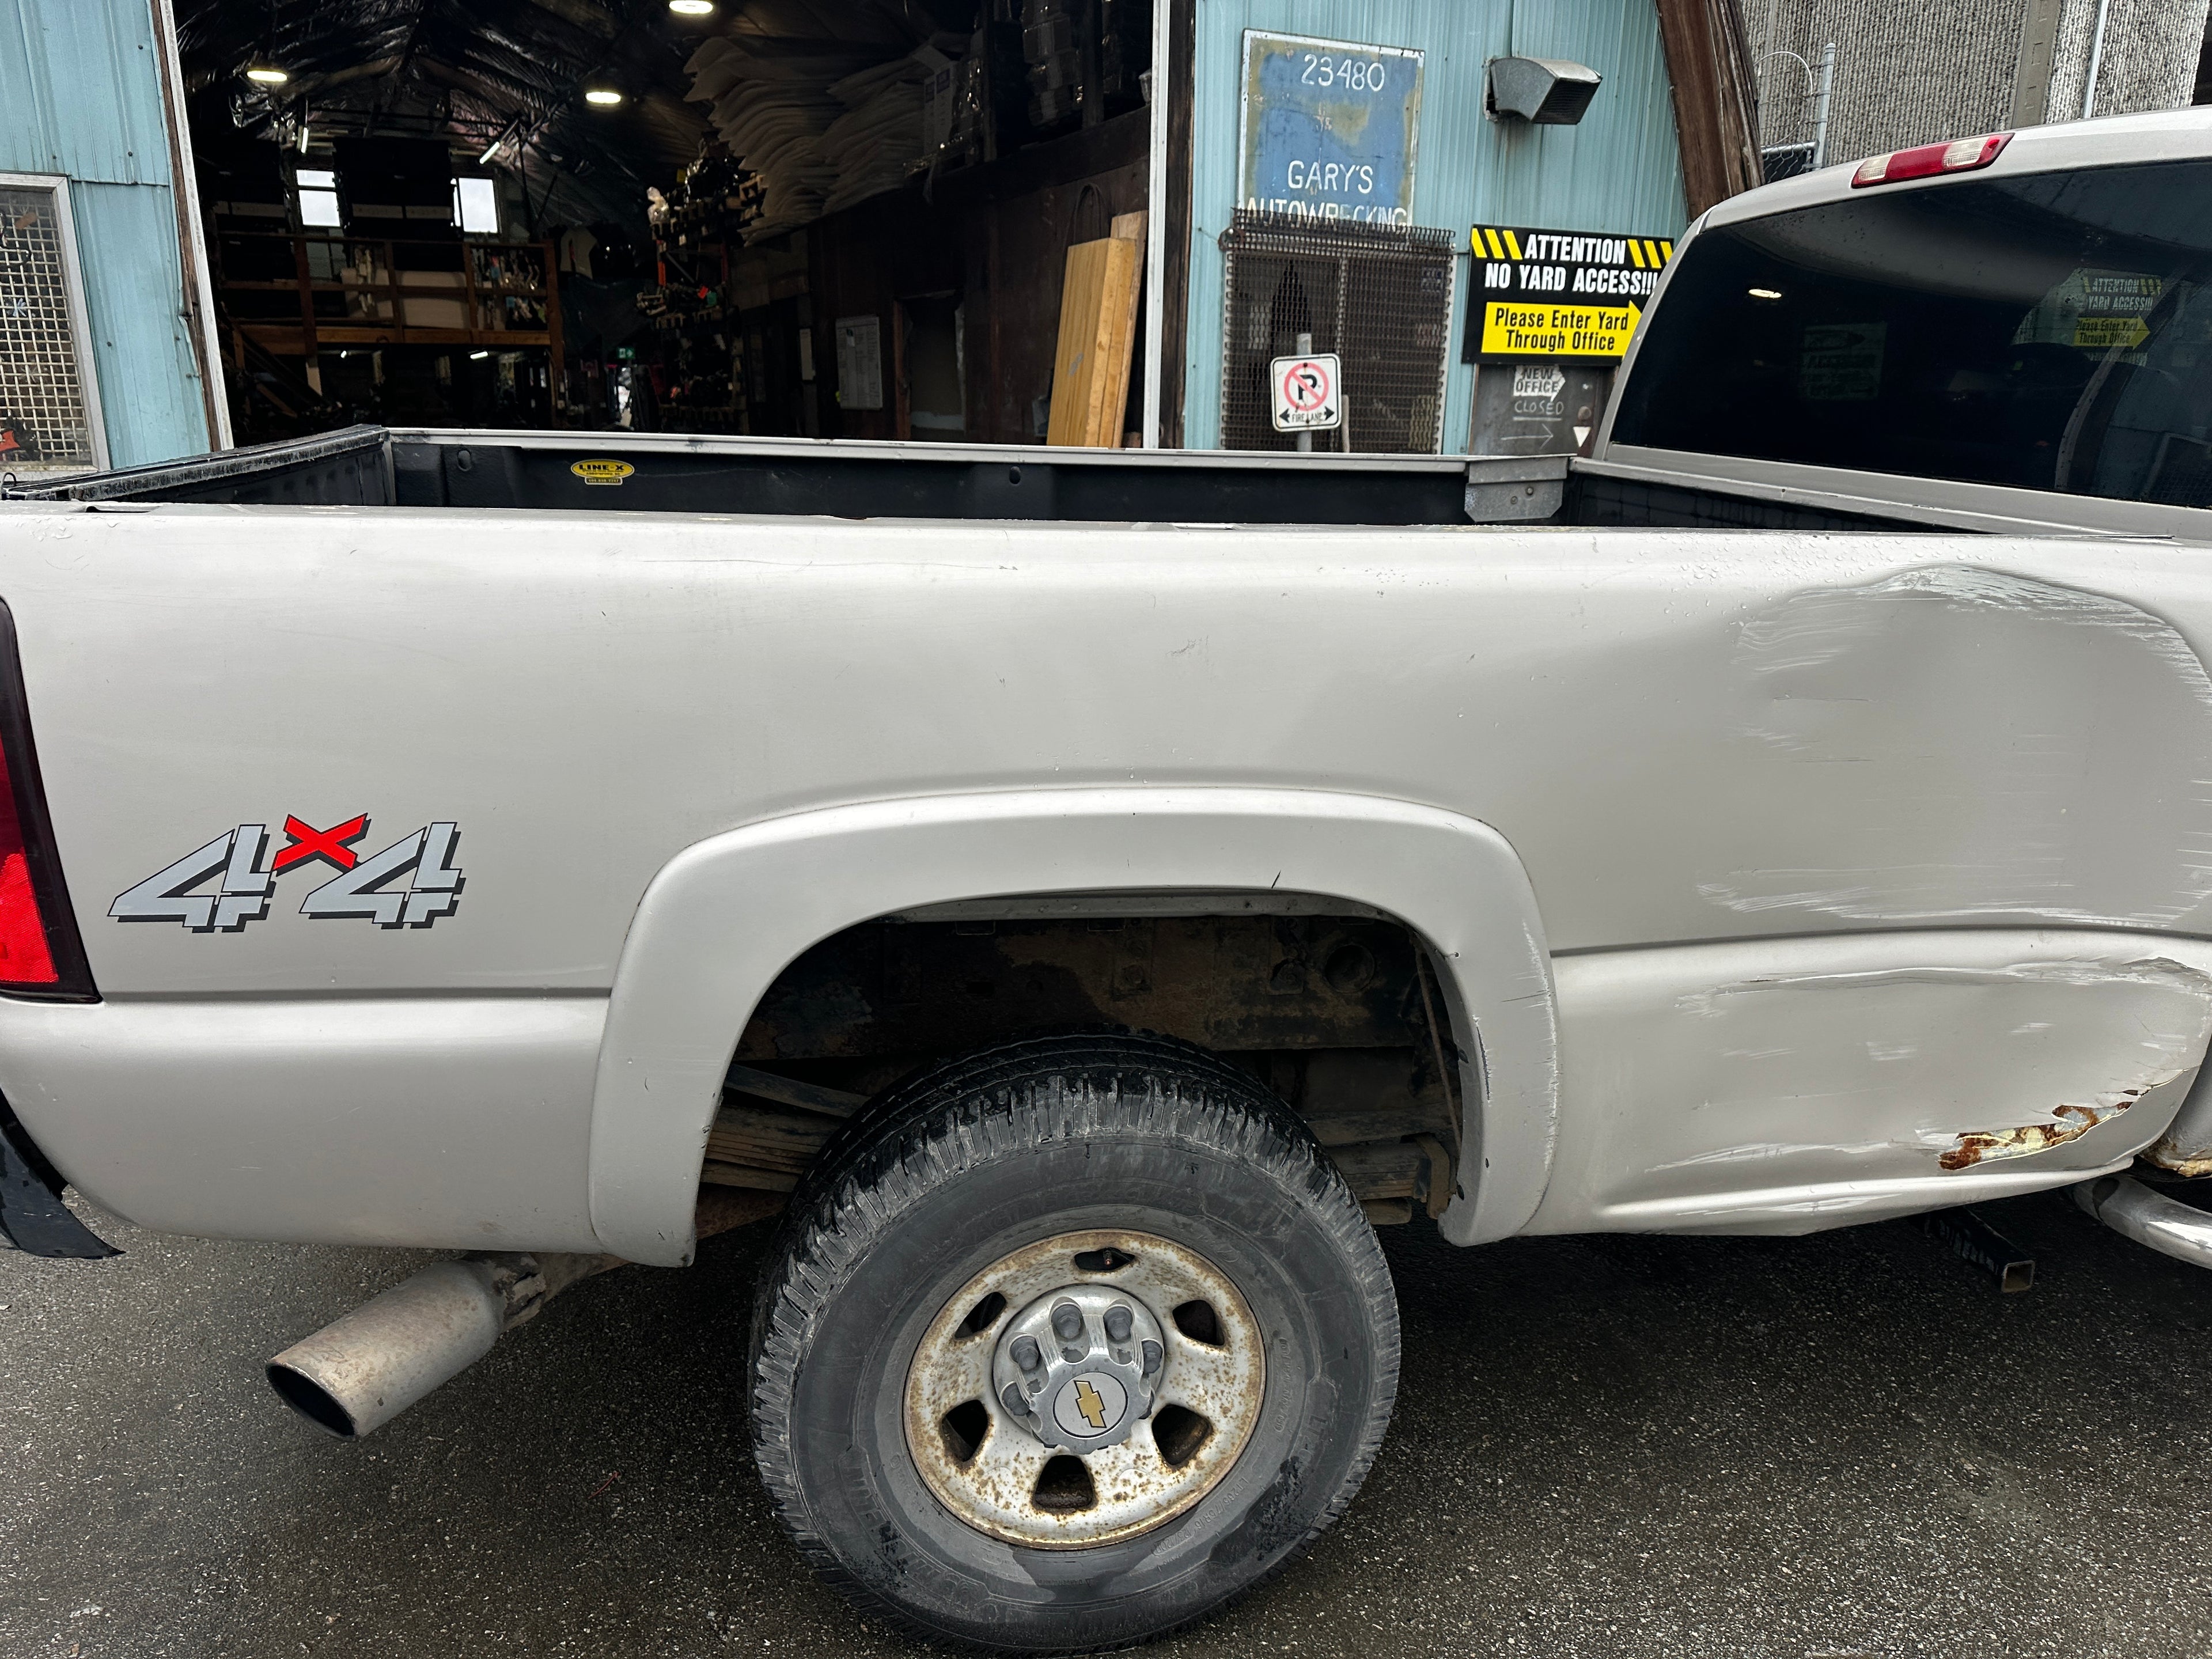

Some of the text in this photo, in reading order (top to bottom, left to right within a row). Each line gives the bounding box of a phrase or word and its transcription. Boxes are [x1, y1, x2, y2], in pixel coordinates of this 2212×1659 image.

[1301, 54, 1385, 92] 23480
[1287, 160, 1374, 194] GARY'S
[1524, 233, 1626, 265] ATTENTION
[1484, 263, 1658, 296] NO YARD ACCESS!!!
[1494, 307, 1629, 331] Please Enter Yard
[1506, 329, 1616, 353] Through Office
[1516, 378, 1559, 393] OFFICE
[1521, 368, 1554, 380] NEW
[1514, 400, 1565, 415] CLOSED
